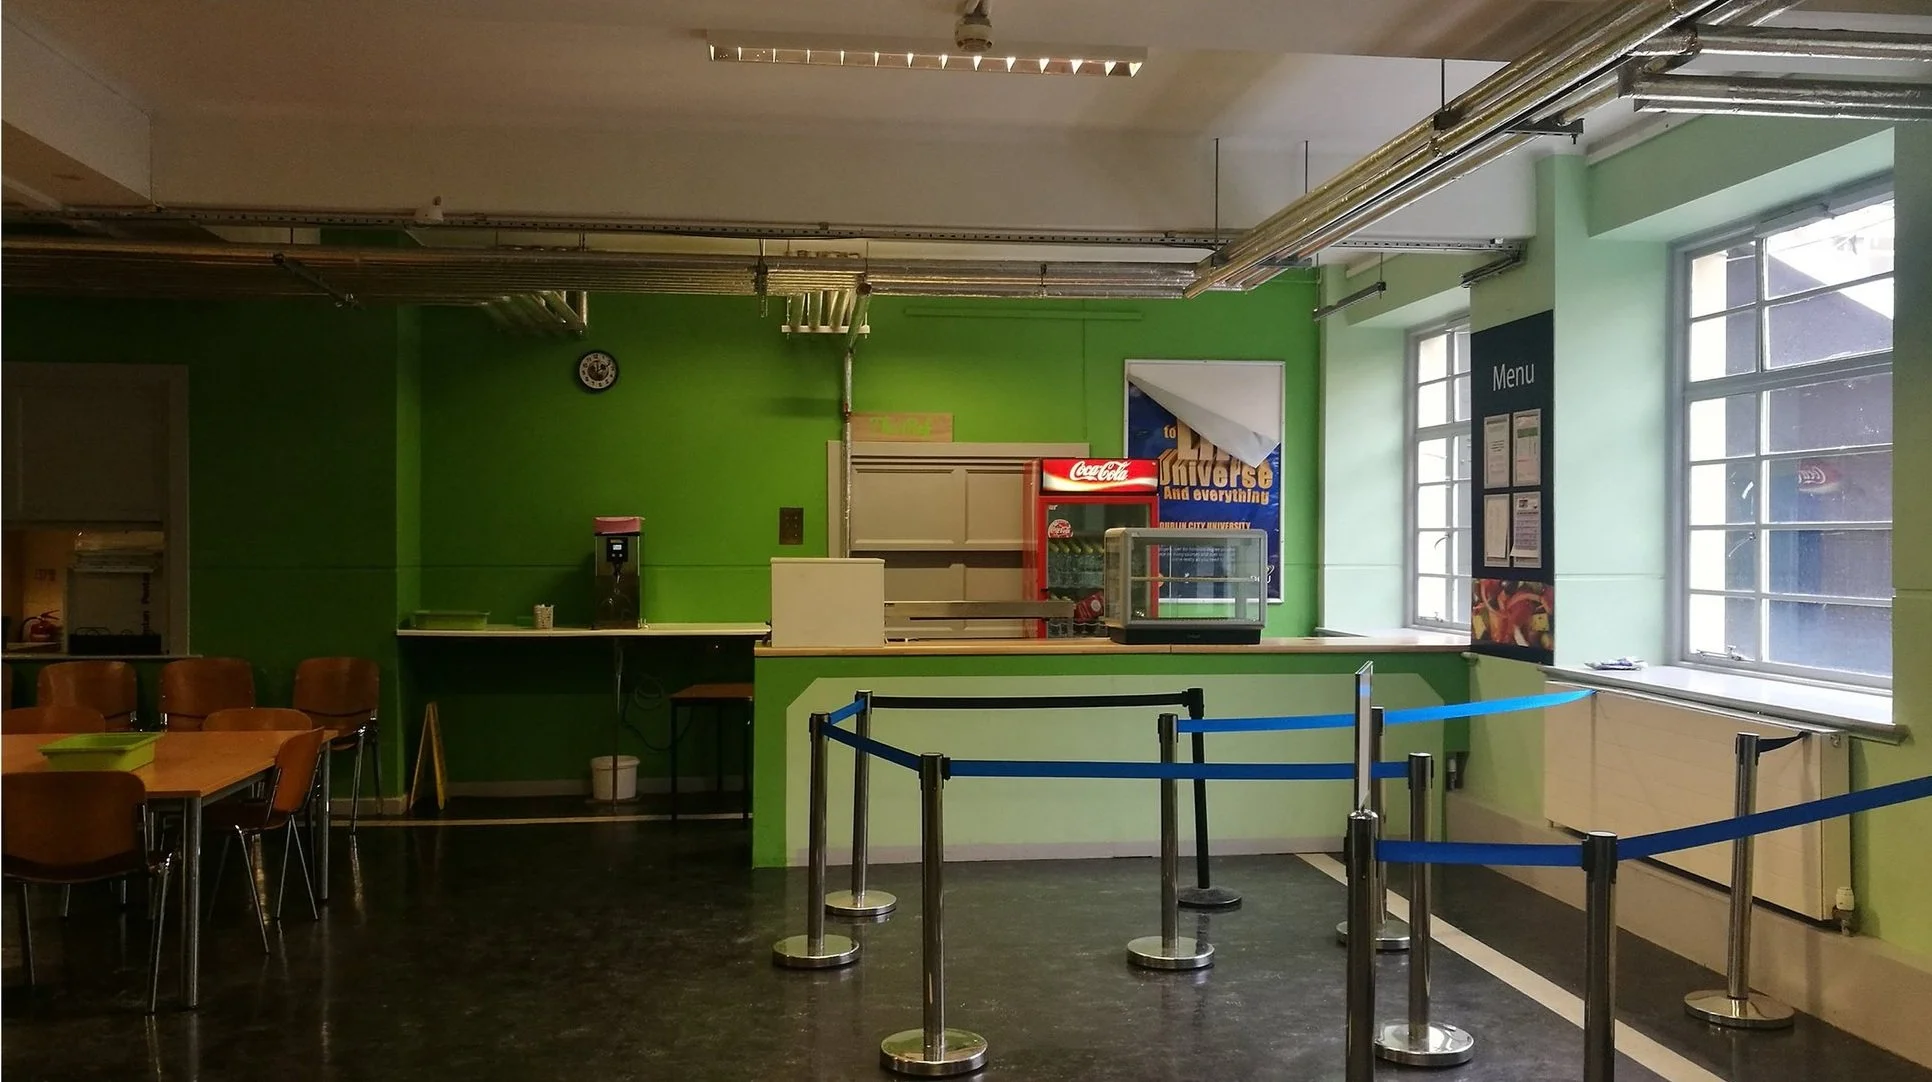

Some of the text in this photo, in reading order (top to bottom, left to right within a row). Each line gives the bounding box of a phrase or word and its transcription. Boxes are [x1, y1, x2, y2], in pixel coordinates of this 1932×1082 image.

[1493, 363, 1535, 391] Menu
[1163, 424, 1177, 439] to
[1069, 460, 1131, 482] Coca-Cola
[1164, 486, 1270, 505] And everything
